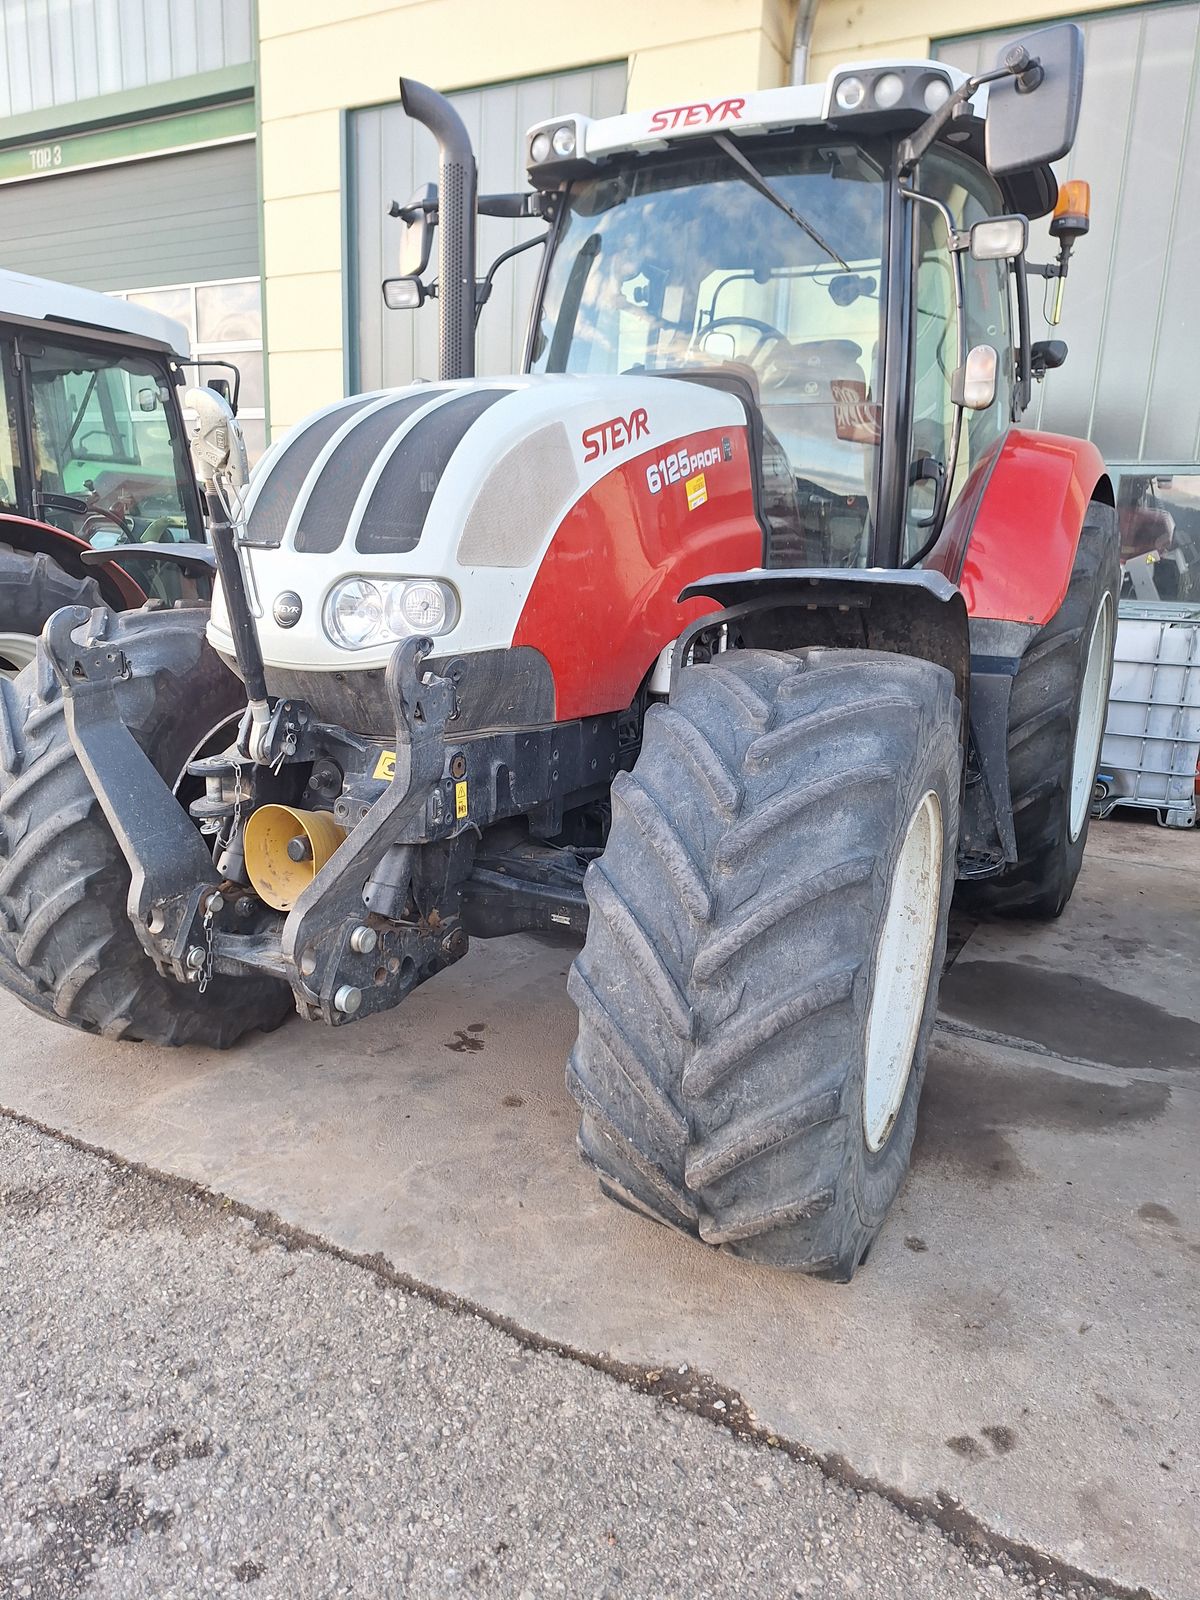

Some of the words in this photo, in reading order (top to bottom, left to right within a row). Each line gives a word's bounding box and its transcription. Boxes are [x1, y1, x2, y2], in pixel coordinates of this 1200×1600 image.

[648, 98, 745, 132] STEYR
[29, 147, 51, 170] TOR
[53, 145, 62, 166] 3
[582, 408, 650, 463] STEYR
